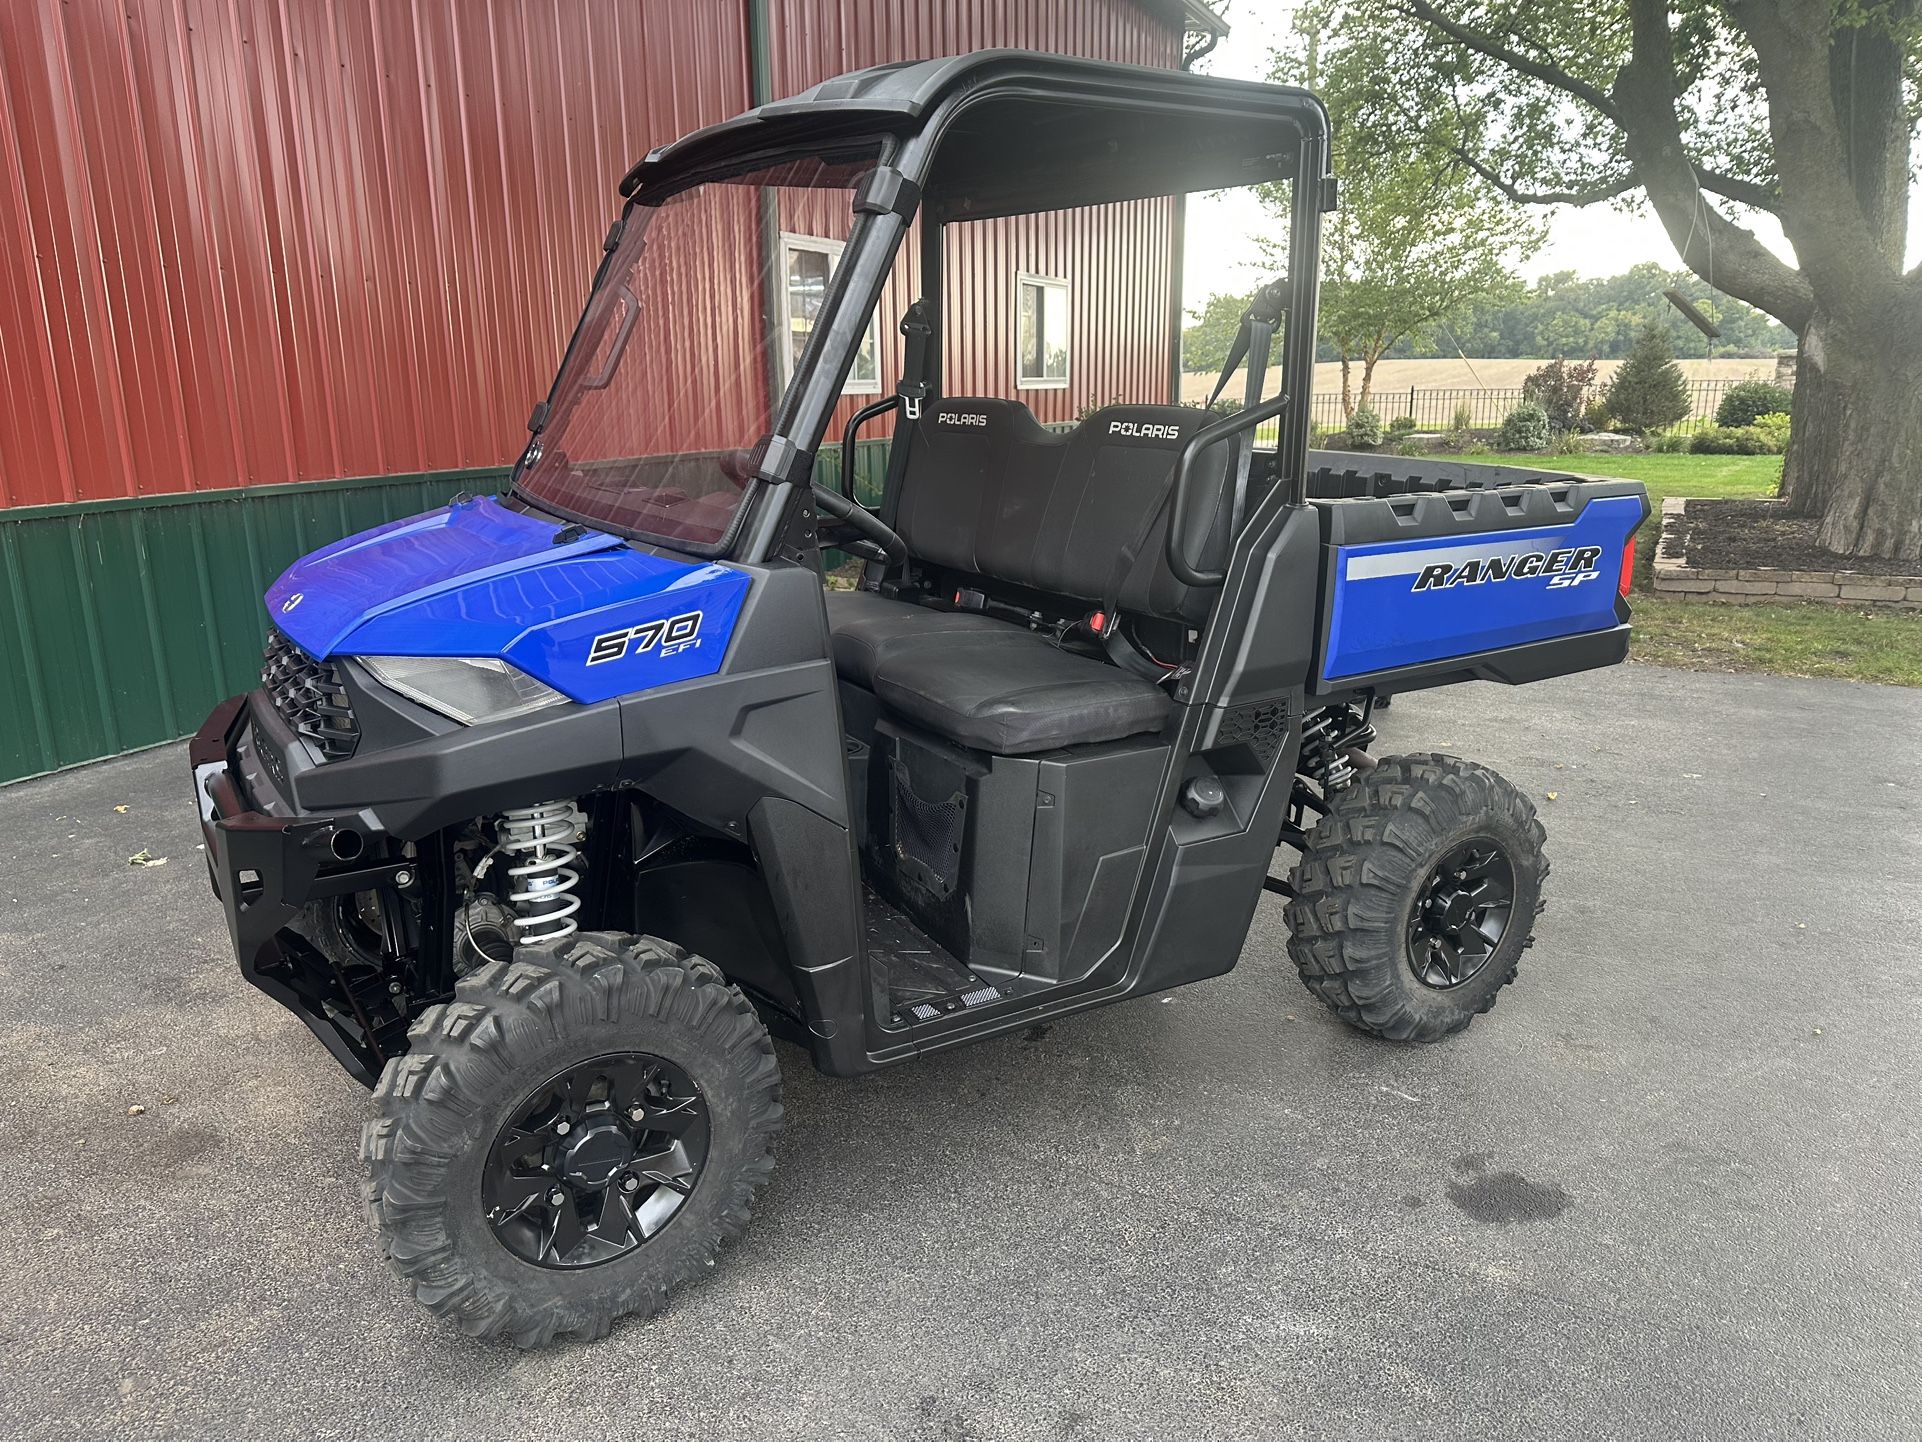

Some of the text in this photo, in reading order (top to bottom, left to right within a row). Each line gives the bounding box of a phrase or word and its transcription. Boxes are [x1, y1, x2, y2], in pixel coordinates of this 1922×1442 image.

[938, 412, 987, 426] POLARIS
[1108, 421, 1180, 440] POLARIS
[1411, 545, 1602, 592] RANGER
[1546, 570, 1600, 589] SP
[585, 610, 703, 667] 570
[659, 638, 702, 658] EFI
